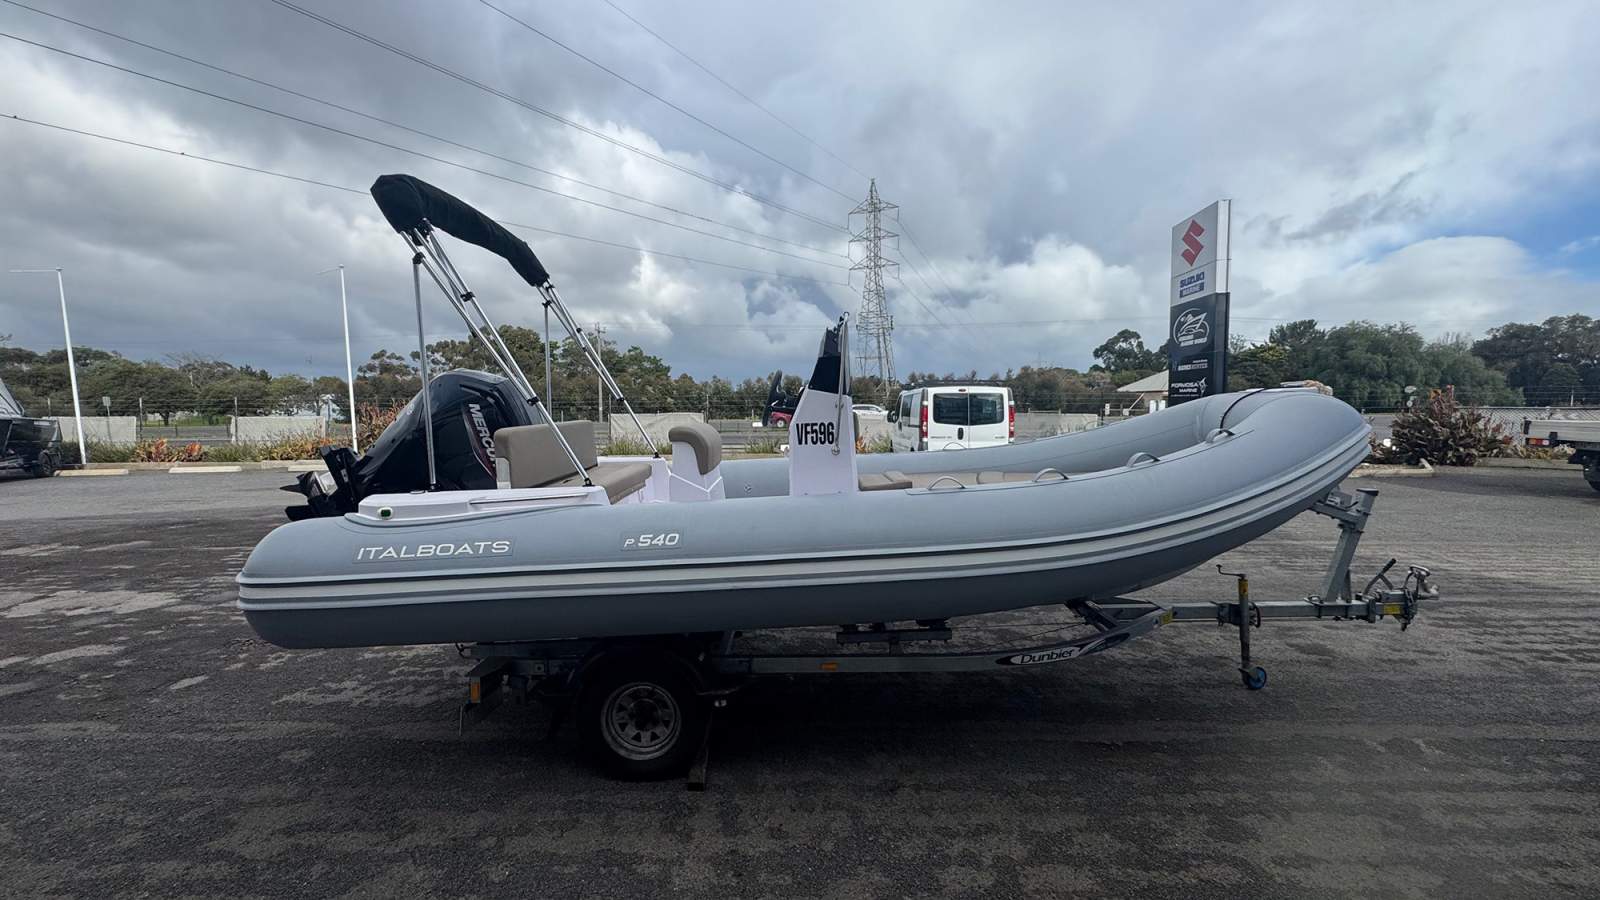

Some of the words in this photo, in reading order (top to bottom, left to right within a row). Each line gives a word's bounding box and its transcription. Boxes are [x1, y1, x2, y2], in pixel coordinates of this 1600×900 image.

[469, 403, 496, 467] MERCU
[796, 422, 835, 445] VF596
[638, 533, 680, 547] 540
[357, 541, 511, 560] ITALBOATS
[1020, 648, 1075, 663] Dunbier
